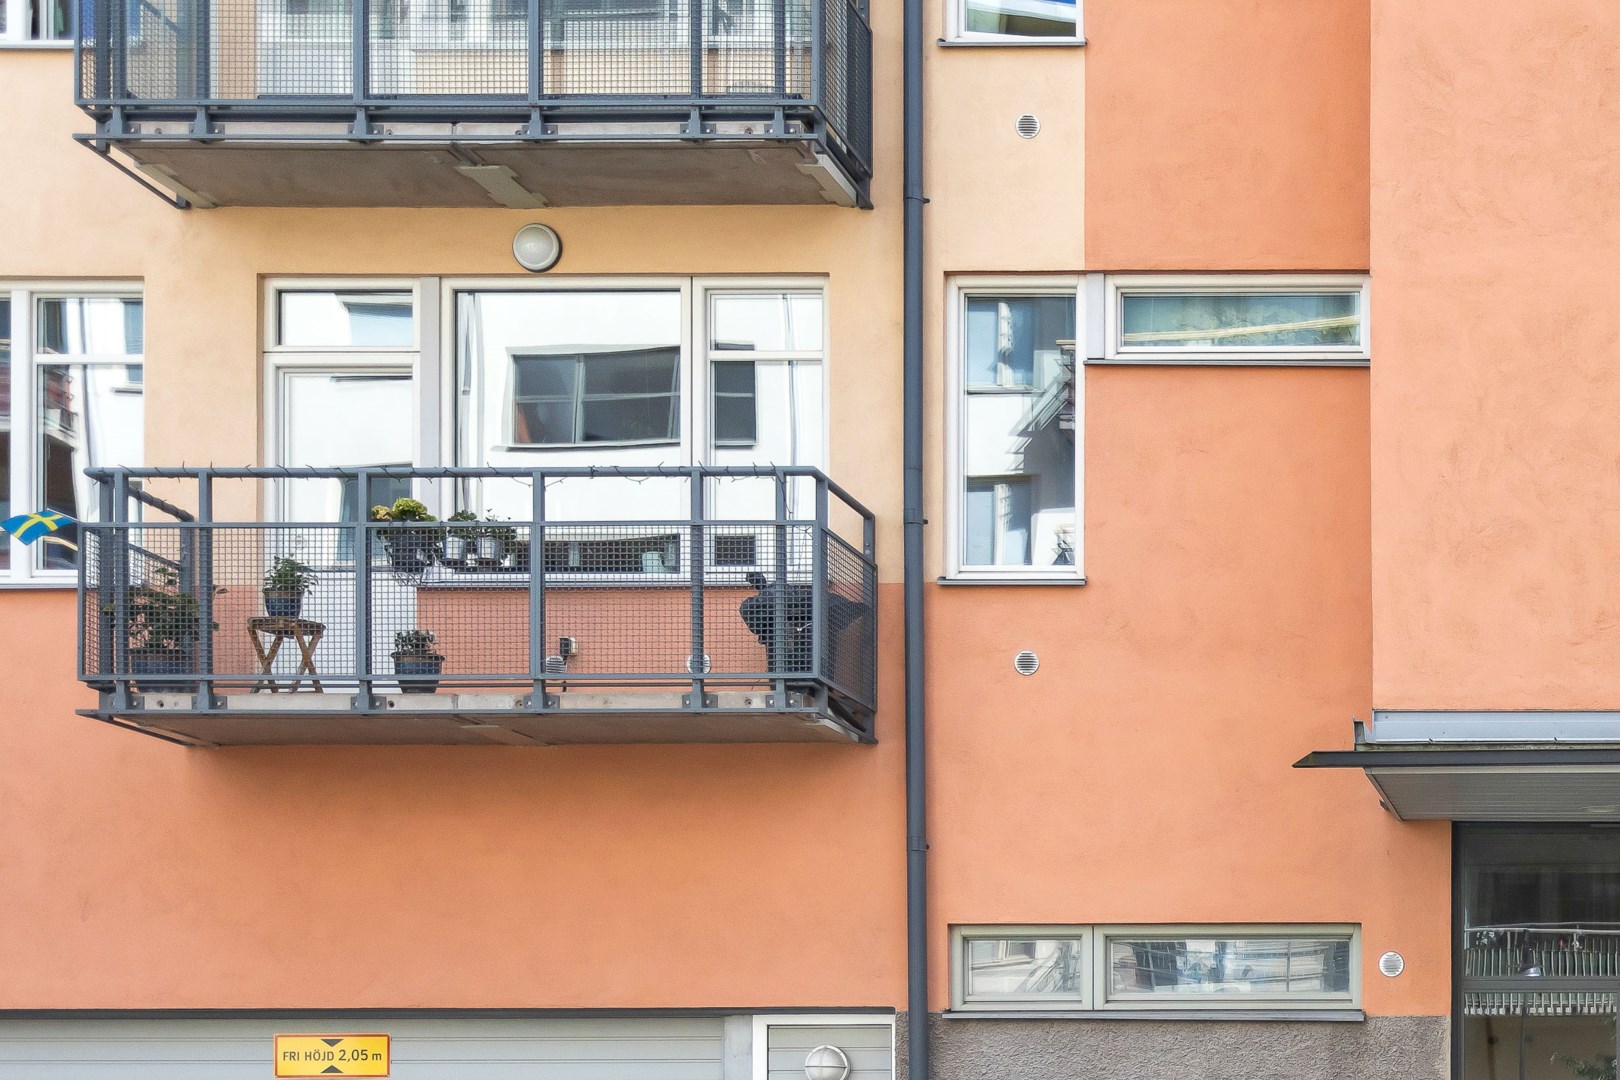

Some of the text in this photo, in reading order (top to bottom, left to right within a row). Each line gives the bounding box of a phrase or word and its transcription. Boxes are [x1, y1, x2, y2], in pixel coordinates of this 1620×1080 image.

[283, 1049, 382, 1063] FRI HÖJD 2,05 m
